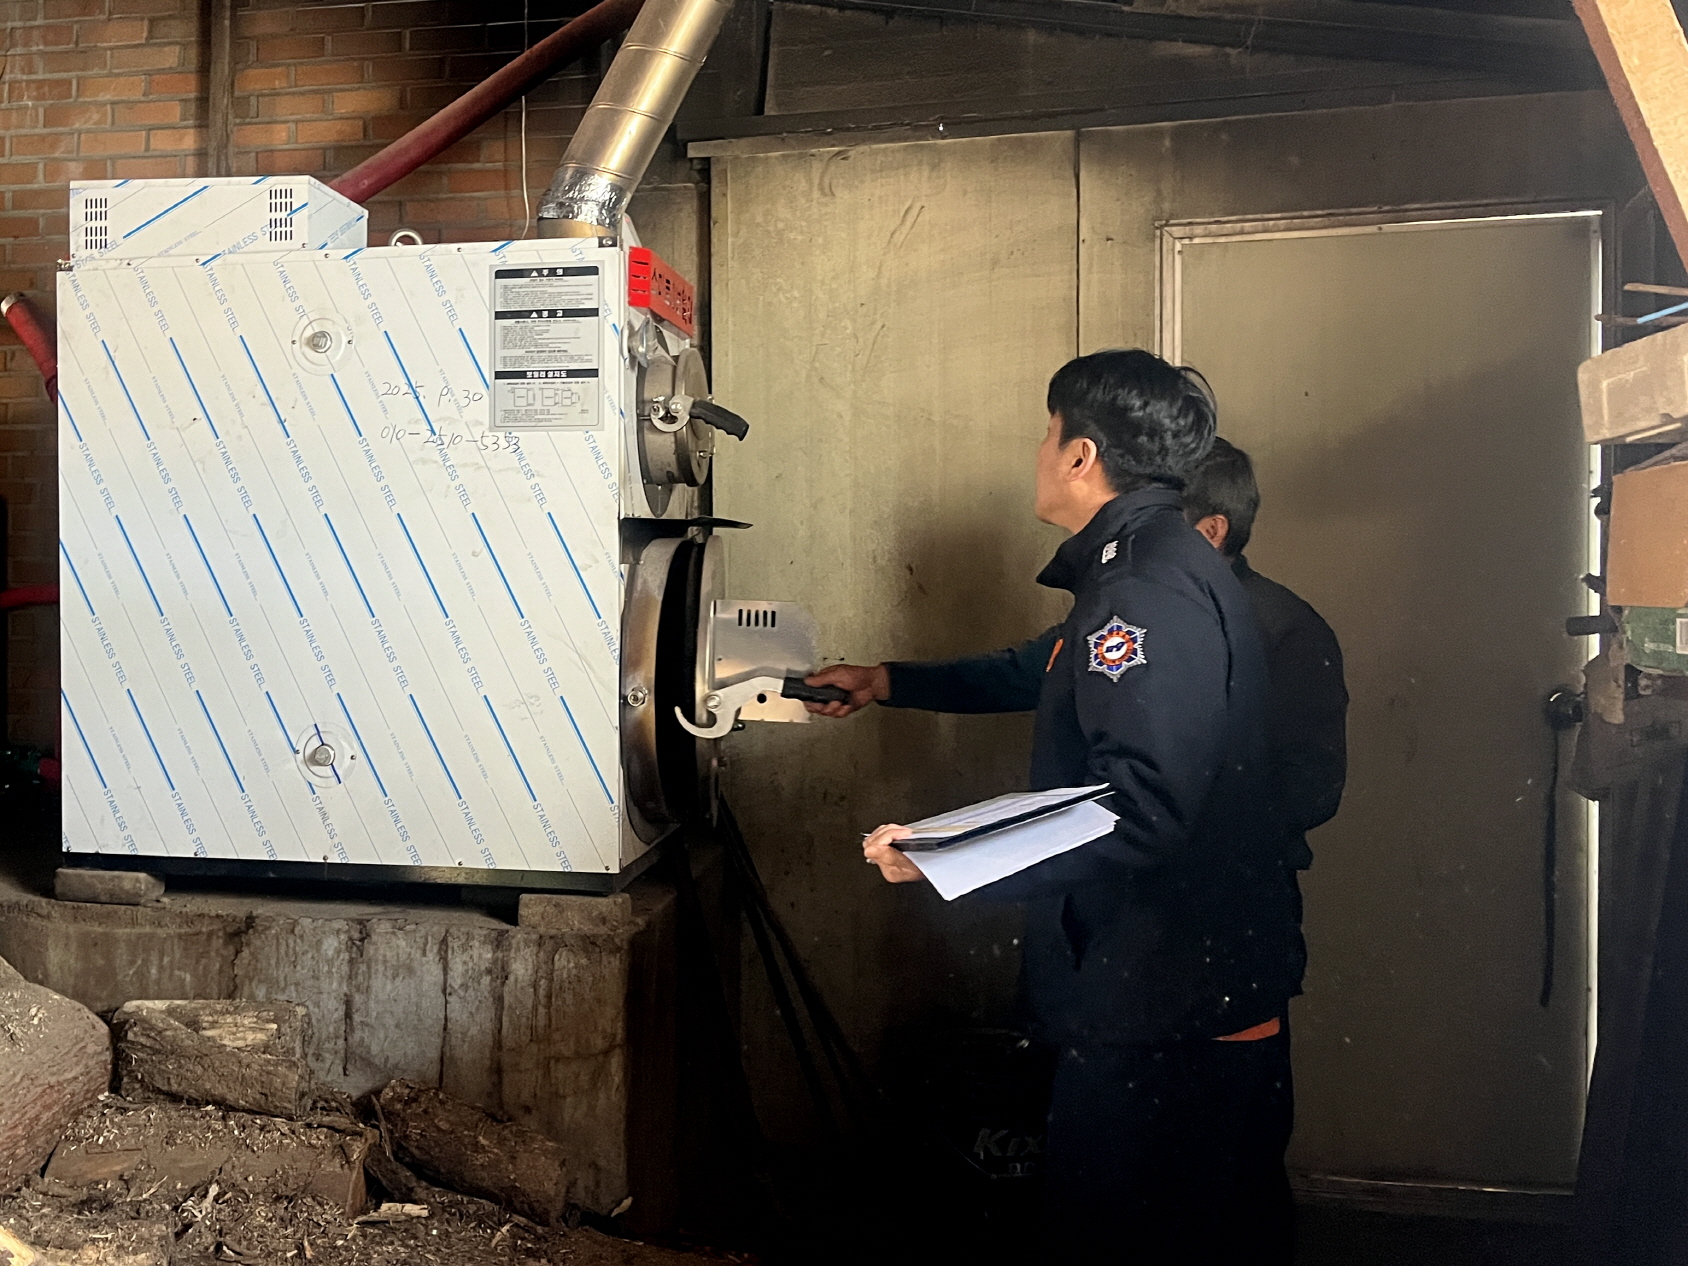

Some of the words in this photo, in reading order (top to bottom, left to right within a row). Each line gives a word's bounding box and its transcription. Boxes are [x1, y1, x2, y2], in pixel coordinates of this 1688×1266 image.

[85, 312, 100, 336] STEEL
[154, 309, 169, 334] STEEL
[223, 307, 239, 332] STEEL
[367, 302, 383, 327] STEEL
[441, 299, 458, 325] STEEL
[78, 442, 103, 485] STAINLESS
[99, 487, 114, 512] STEEL
[146, 441, 171, 484] STAINLESS
[167, 486, 183, 511] STEEL
[215, 440, 240, 483] STAINLESS
[236, 485, 252, 511] STEEL
[286, 439, 312, 483] STAINLESS
[307, 485, 324, 511] STEEL
[358, 437, 384, 482] STAINLESS
[380, 484, 396, 510] STEEL
[584, 434, 612, 479] STAINLESS
[454, 483, 471, 509] STEEL
[530, 482, 547, 509] STEEL
[91, 616, 115, 659] STAINLESS
[111, 661, 126, 685] STEEL
[159, 617, 184, 660] STAINLESS
[180, 662, 195, 687] STEEL
[228, 617, 254, 660] STAINLESS
[249, 663, 265, 688] STEEL
[299, 618, 324, 661] STAINLESS
[320, 664, 336, 689] STEEL
[370, 618, 397, 663] STAINLESS
[392, 665, 408, 691] STEEL
[444, 619, 471, 664] STAINLESS
[466, 666, 483, 692] STEEL
[520, 619, 547, 664] STAINLESS
[542, 666, 560, 693] STEEL
[103, 789, 127, 832] STAINLESS
[171, 791, 196, 835] STAINLESS
[240, 793, 266, 837] STAINLESS
[311, 795, 337, 839] STAINLESS
[383, 798, 410, 842] STAINLESS
[457, 800, 484, 844] STAINLESS
[532, 803, 560, 848] STAINLESS
